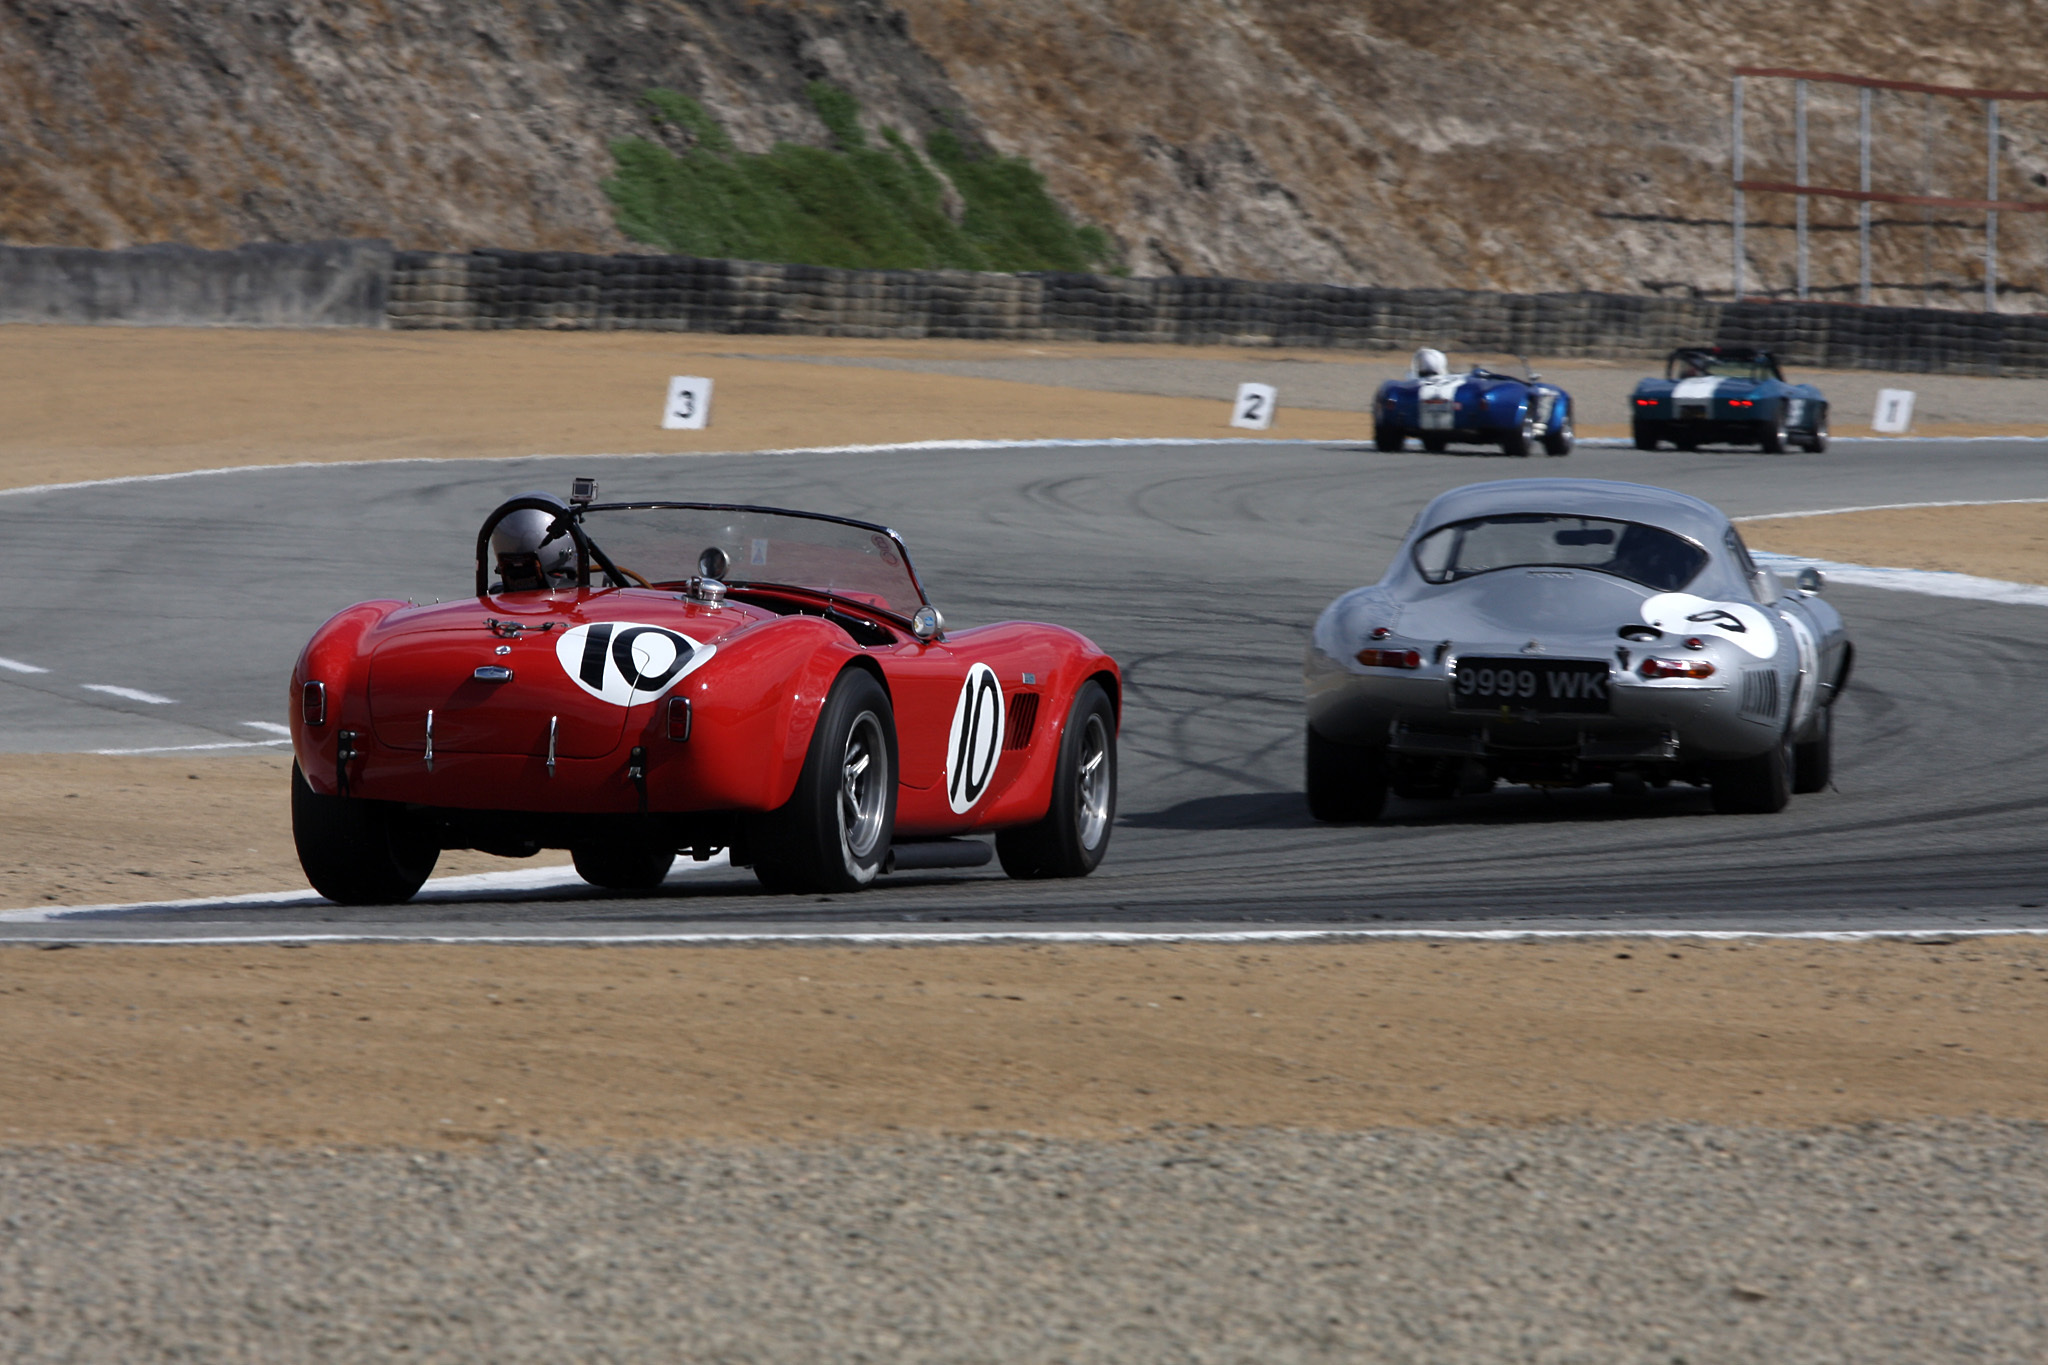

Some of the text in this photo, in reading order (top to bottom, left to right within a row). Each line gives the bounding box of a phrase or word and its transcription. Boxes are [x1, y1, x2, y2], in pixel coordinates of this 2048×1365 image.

[673, 389, 695, 419] 3
[1241, 393, 1265, 420] 2
[579, 623, 696, 692] 10
[1457, 667, 1607, 699] 9999 WK
[949, 669, 1001, 803] 10
